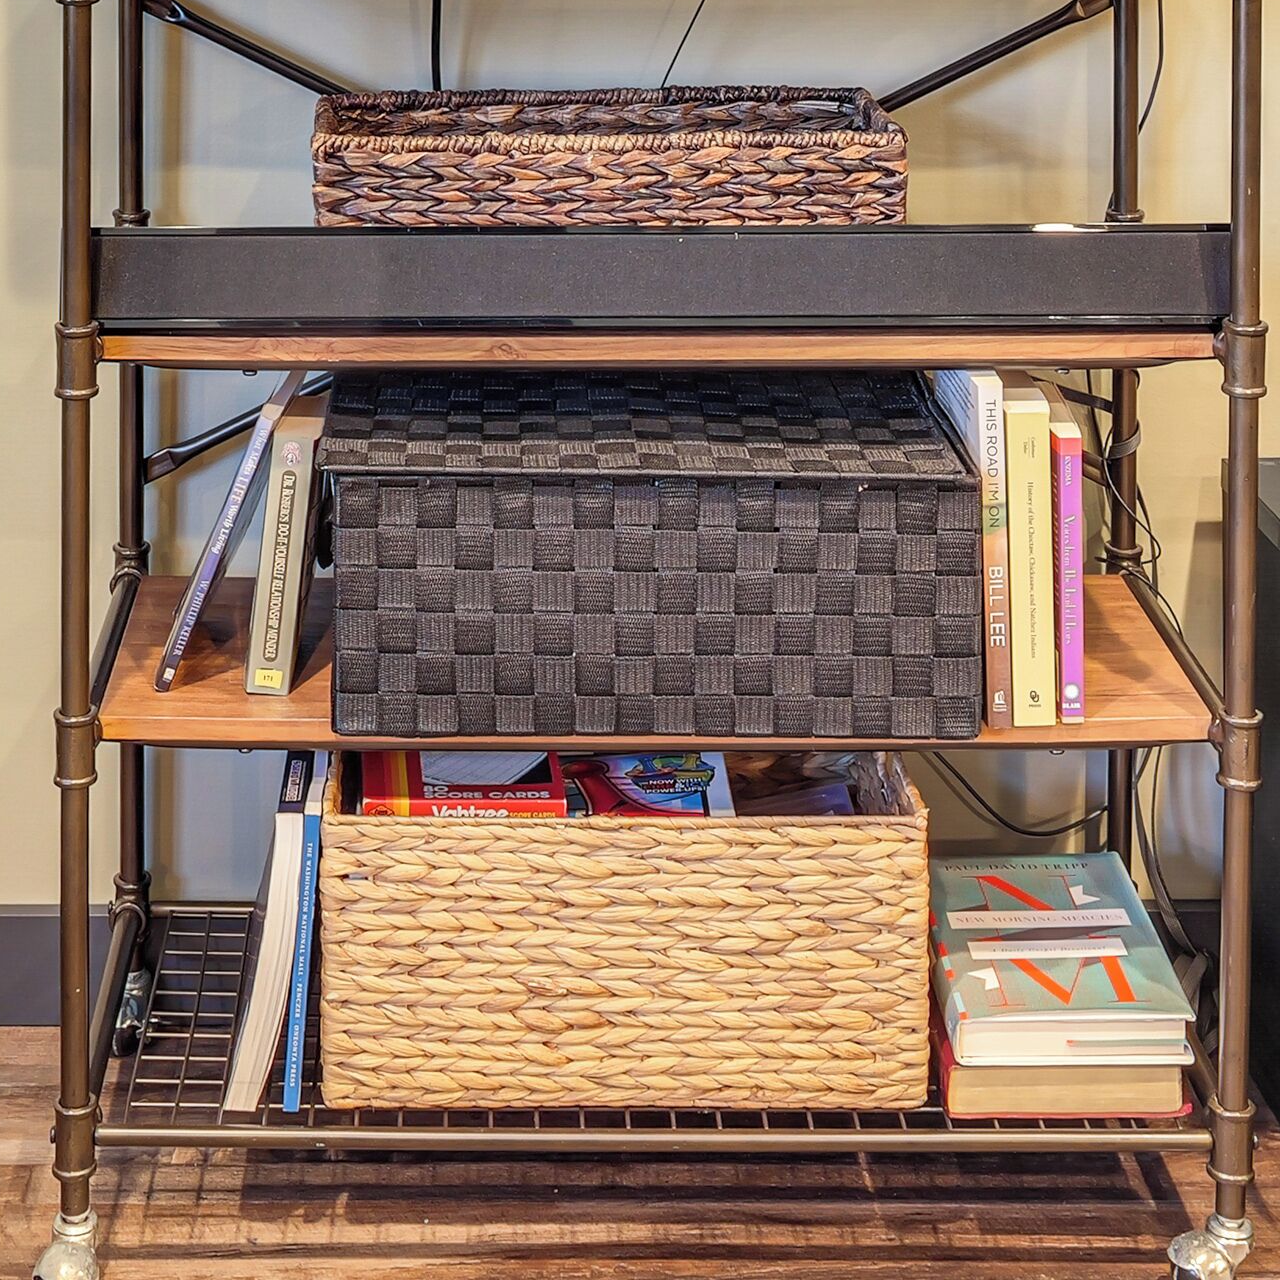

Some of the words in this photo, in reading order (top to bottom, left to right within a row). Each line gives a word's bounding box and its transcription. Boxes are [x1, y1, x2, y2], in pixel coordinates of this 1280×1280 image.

[986, 400, 997, 431] THIS
[253, 429, 268, 449] What
[986, 436, 998, 478] ROAD
[231, 477, 249, 504] LIFE
[988, 483, 999, 501] I'M
[1026, 482, 1034, 506] History
[223, 505, 239, 527] Worth
[989, 505, 1000, 528] ON
[211, 528, 230, 554] Living
[273, 524, 289, 579] DO-IT-YOURSELF
[199, 581, 210, 590] W.
[989, 566, 1003, 606] BILL
[186, 592, 205, 624] PHILLIP
[268, 580, 283, 628] RELATIONSHIP
[173, 625, 193, 655] KELLER
[265, 628, 279, 659] MENDER
[990, 612, 1006, 647] LEE
[488, 791, 550, 799] CARDS
[945, 863, 984, 871] PAUL
[988, 862, 1037, 871] DAVID
[1042, 862, 1089, 870] TRIPP
[302, 860, 312, 913] WASHINGTON
[299, 914, 308, 953] NATIONAL
[992, 915, 1057, 923] MORNING
[1062, 914, 1123, 922] MERCIES
[294, 983, 303, 1018] PENCZER
[292, 1024, 300, 1062] ONEONTA
[289, 1064, 297, 1087] PRESS
